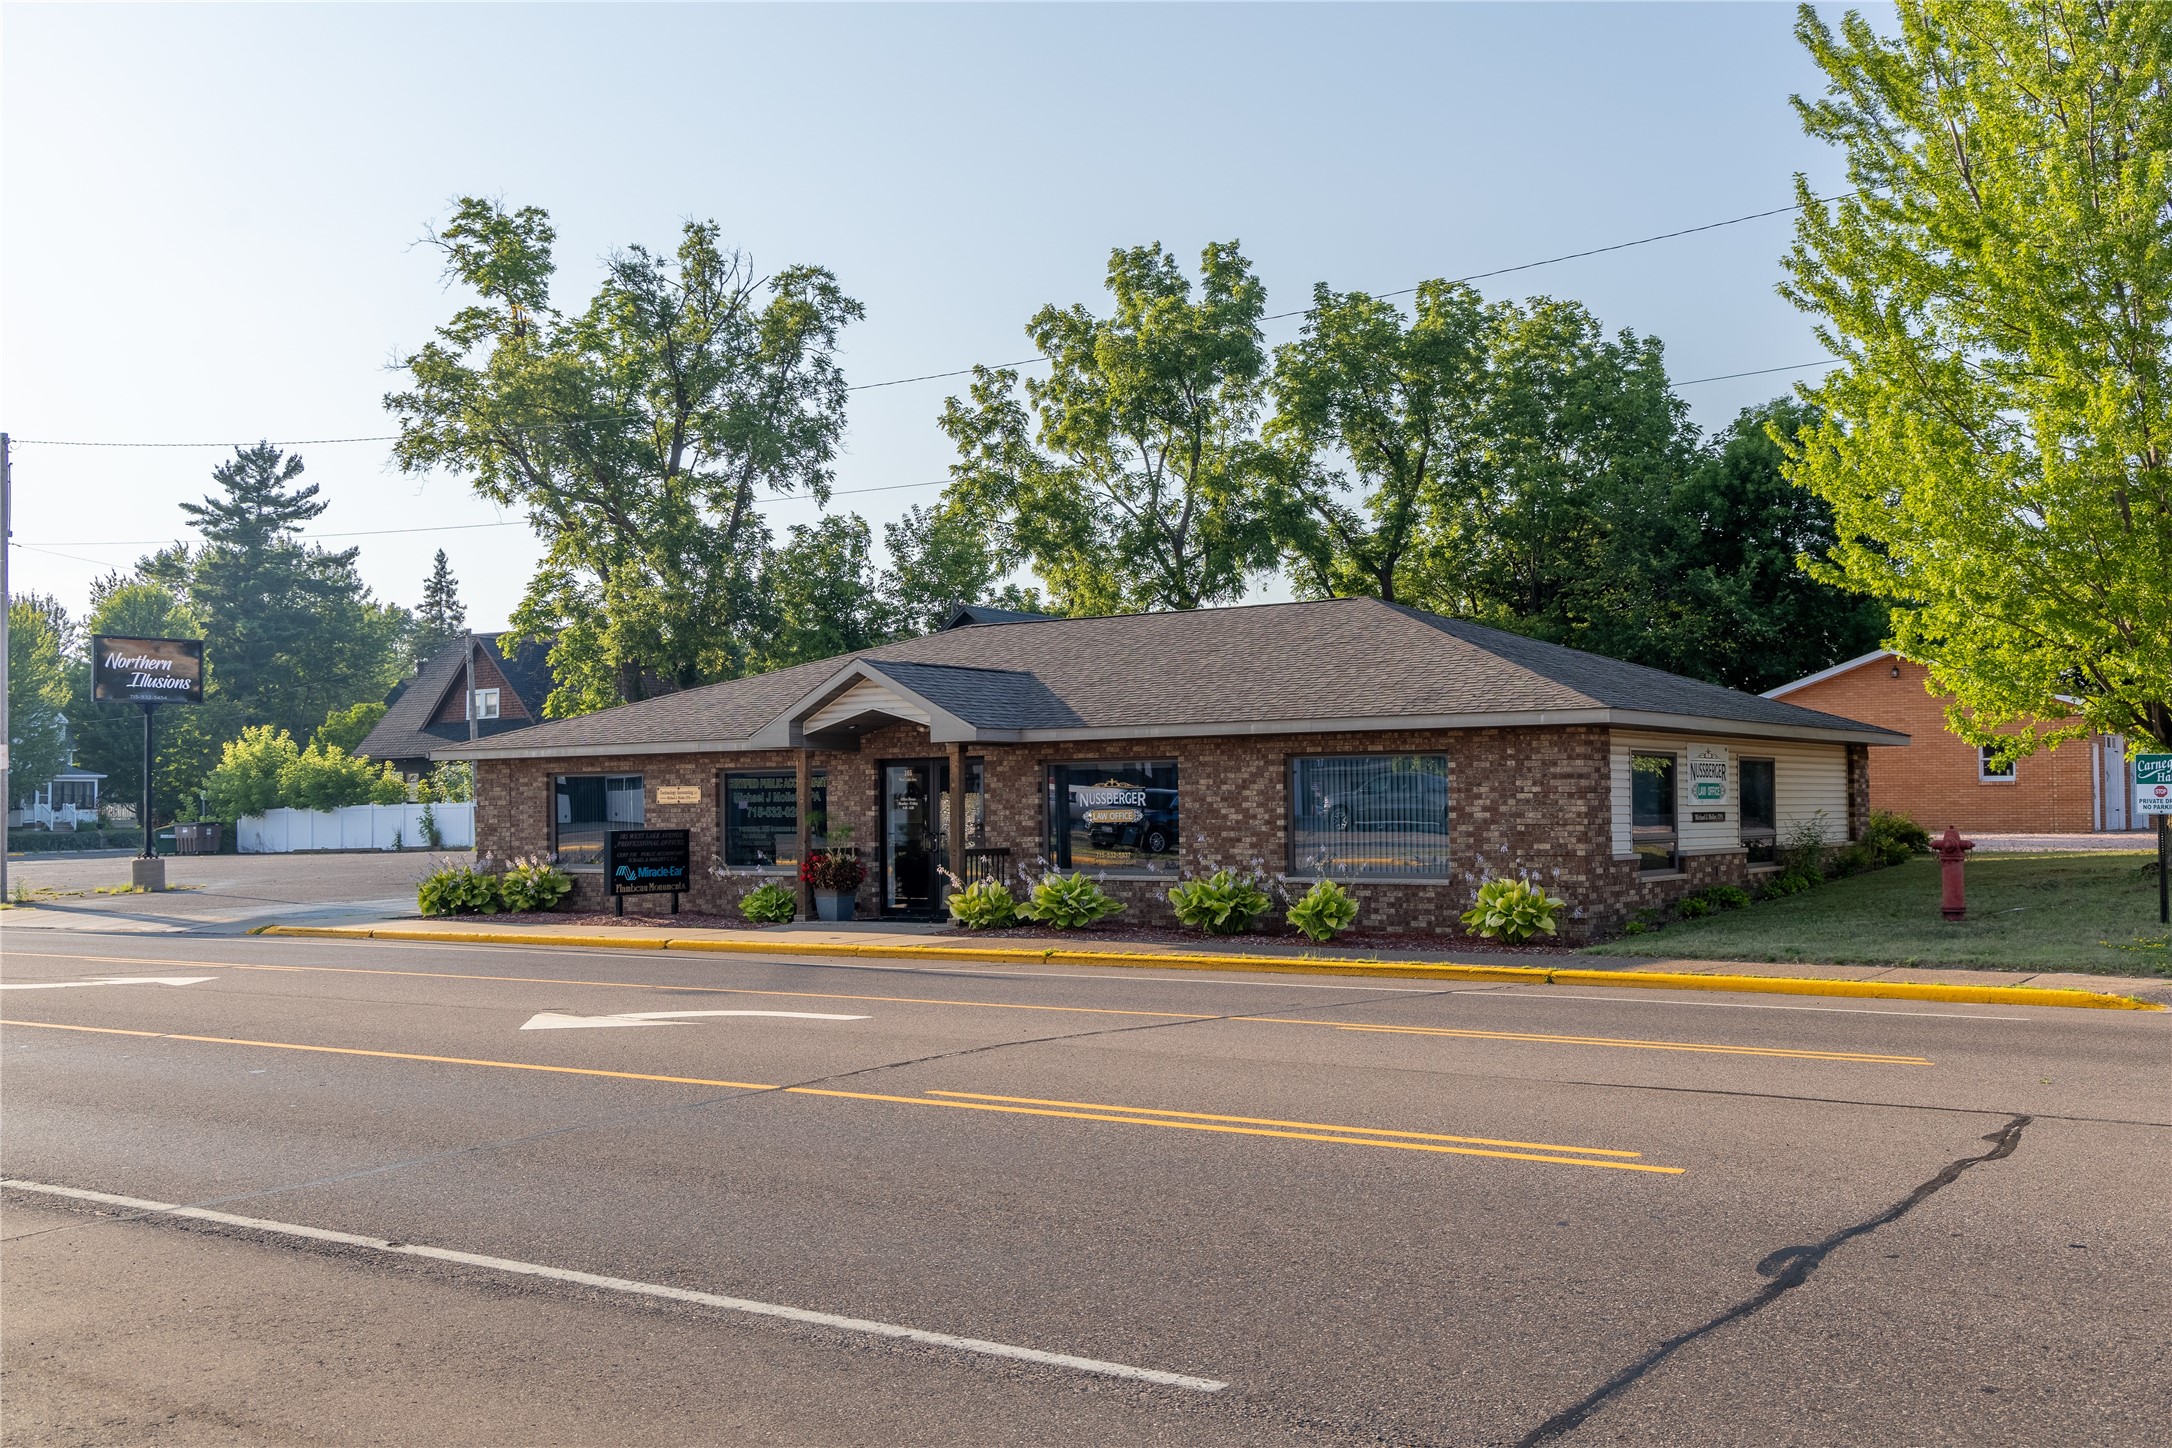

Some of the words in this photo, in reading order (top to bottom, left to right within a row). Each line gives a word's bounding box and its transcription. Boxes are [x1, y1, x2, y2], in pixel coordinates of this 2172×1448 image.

[104, 652, 172, 671] Northern
[126, 672, 192, 690] Illusions
[1690, 763, 1726, 781] NUSSBERGER
[2157, 773, 2172, 782] Ha
[728, 778, 759, 789] CERTIFIED
[760, 778, 782, 788] PUBLIC
[1698, 786, 1706, 796] LAW
[1708, 786, 1720, 796] OFFICE
[733, 792, 764, 803] Michael
[766, 792, 771, 802] J
[772, 792, 797, 802] Molle
[1080, 792, 1146, 807] NUSSBERGER
[638, 866, 683, 878] Miracle-Ear
[616, 883, 648, 893] Flambeau
[649, 882, 686, 892] Monuments
